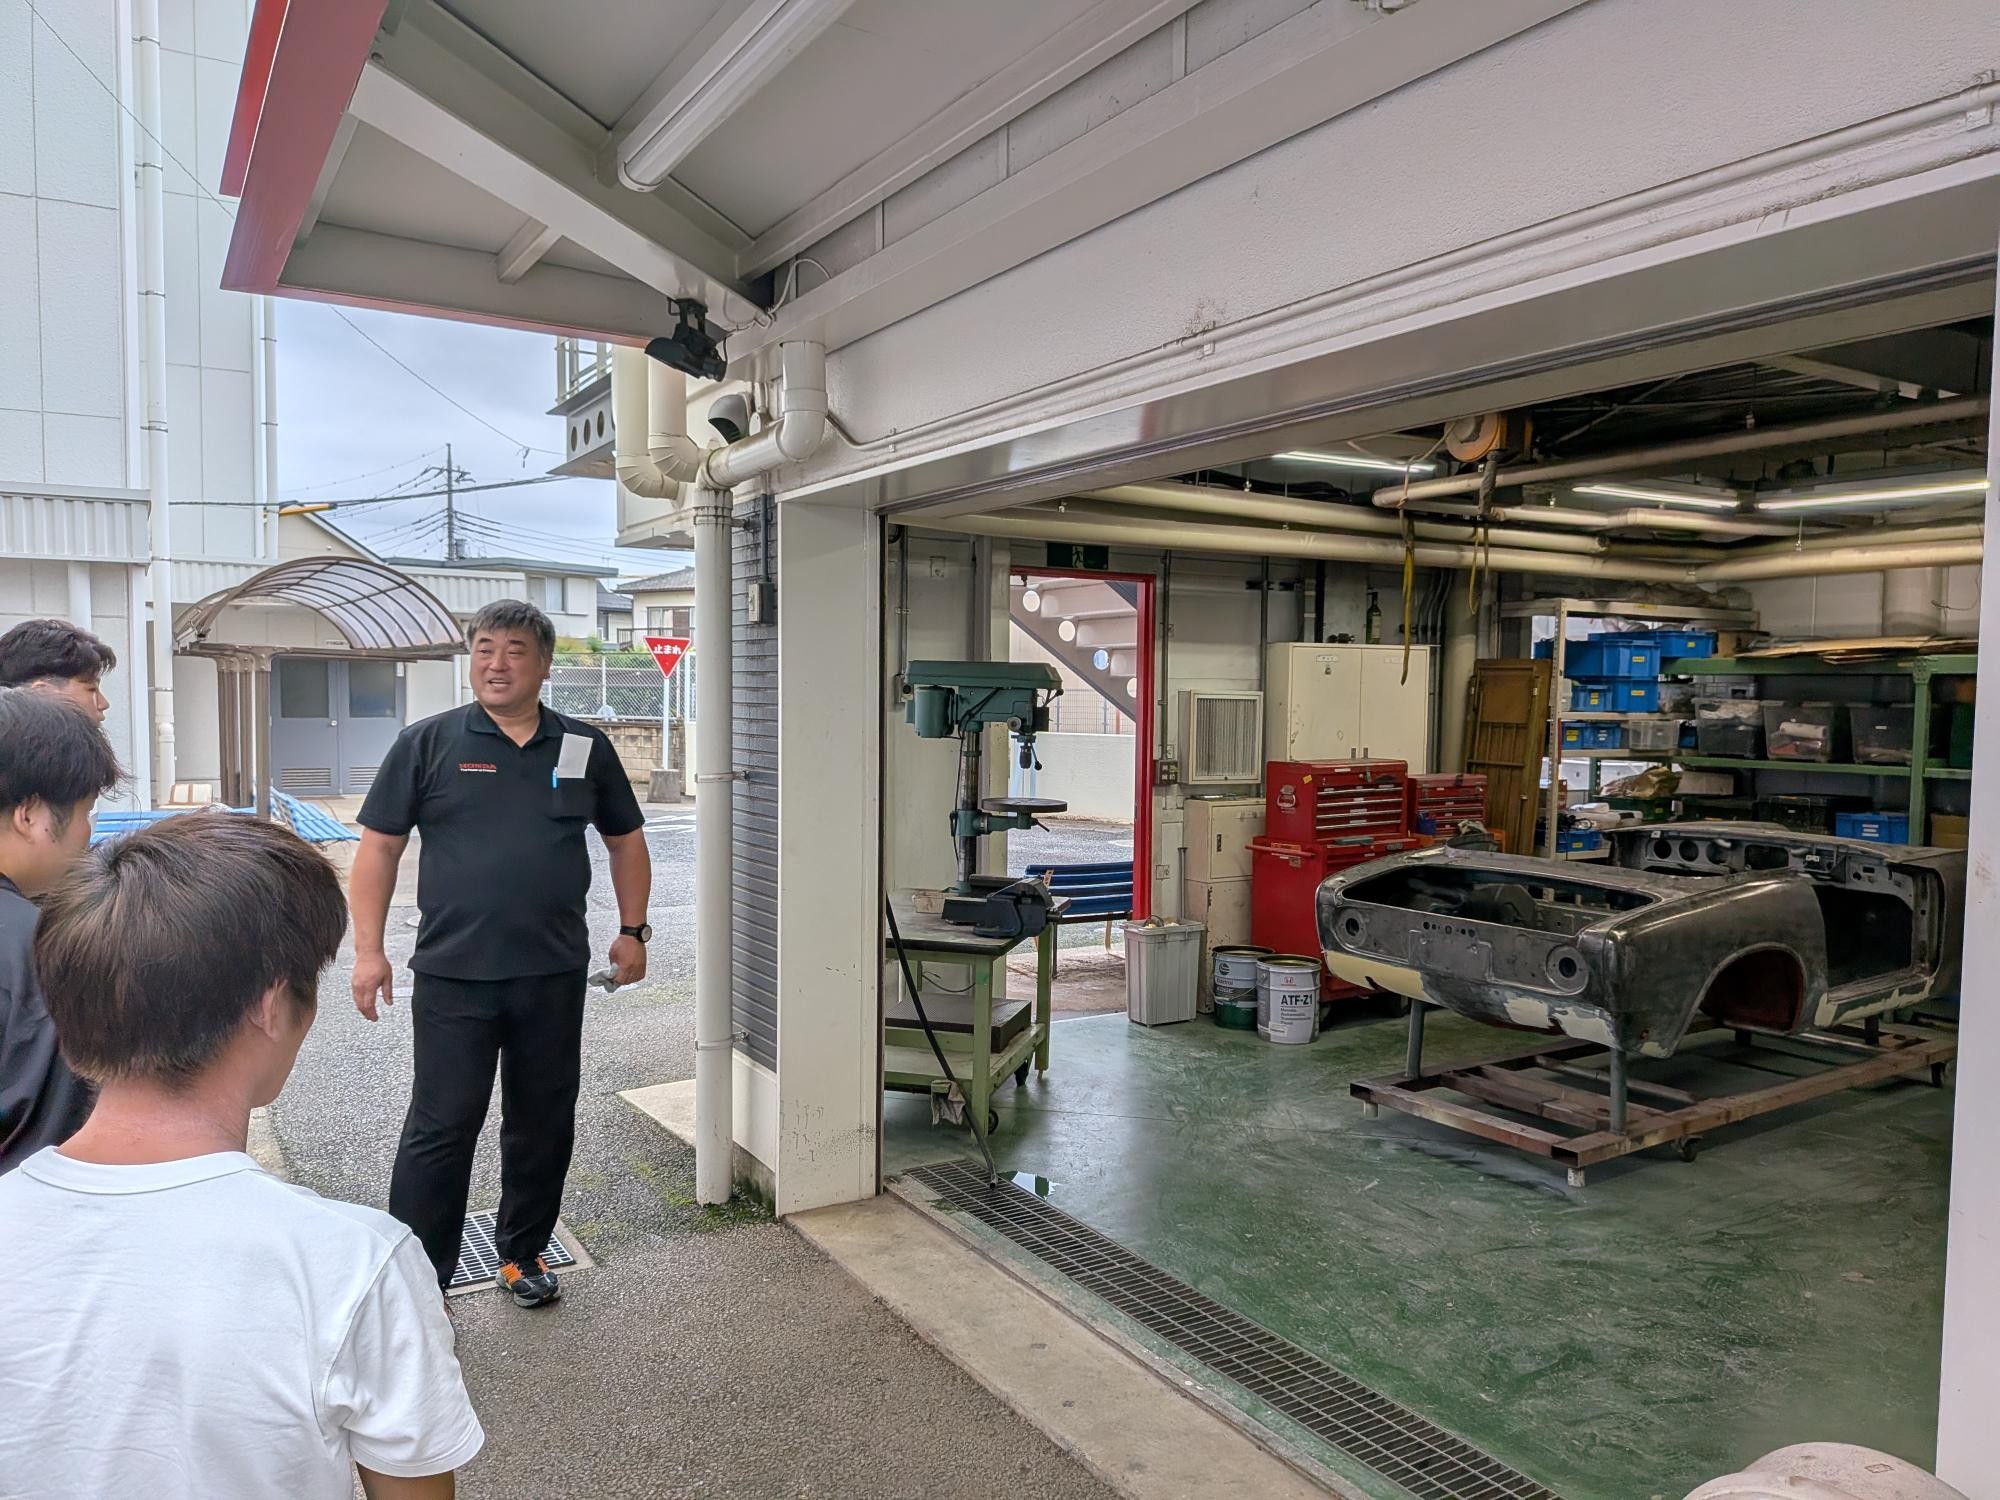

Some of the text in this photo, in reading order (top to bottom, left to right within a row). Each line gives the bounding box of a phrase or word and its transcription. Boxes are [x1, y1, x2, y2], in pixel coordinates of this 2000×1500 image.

[653, 644, 682, 655] 止まれ
[1281, 994, 1312, 1005] ATF-Z1
